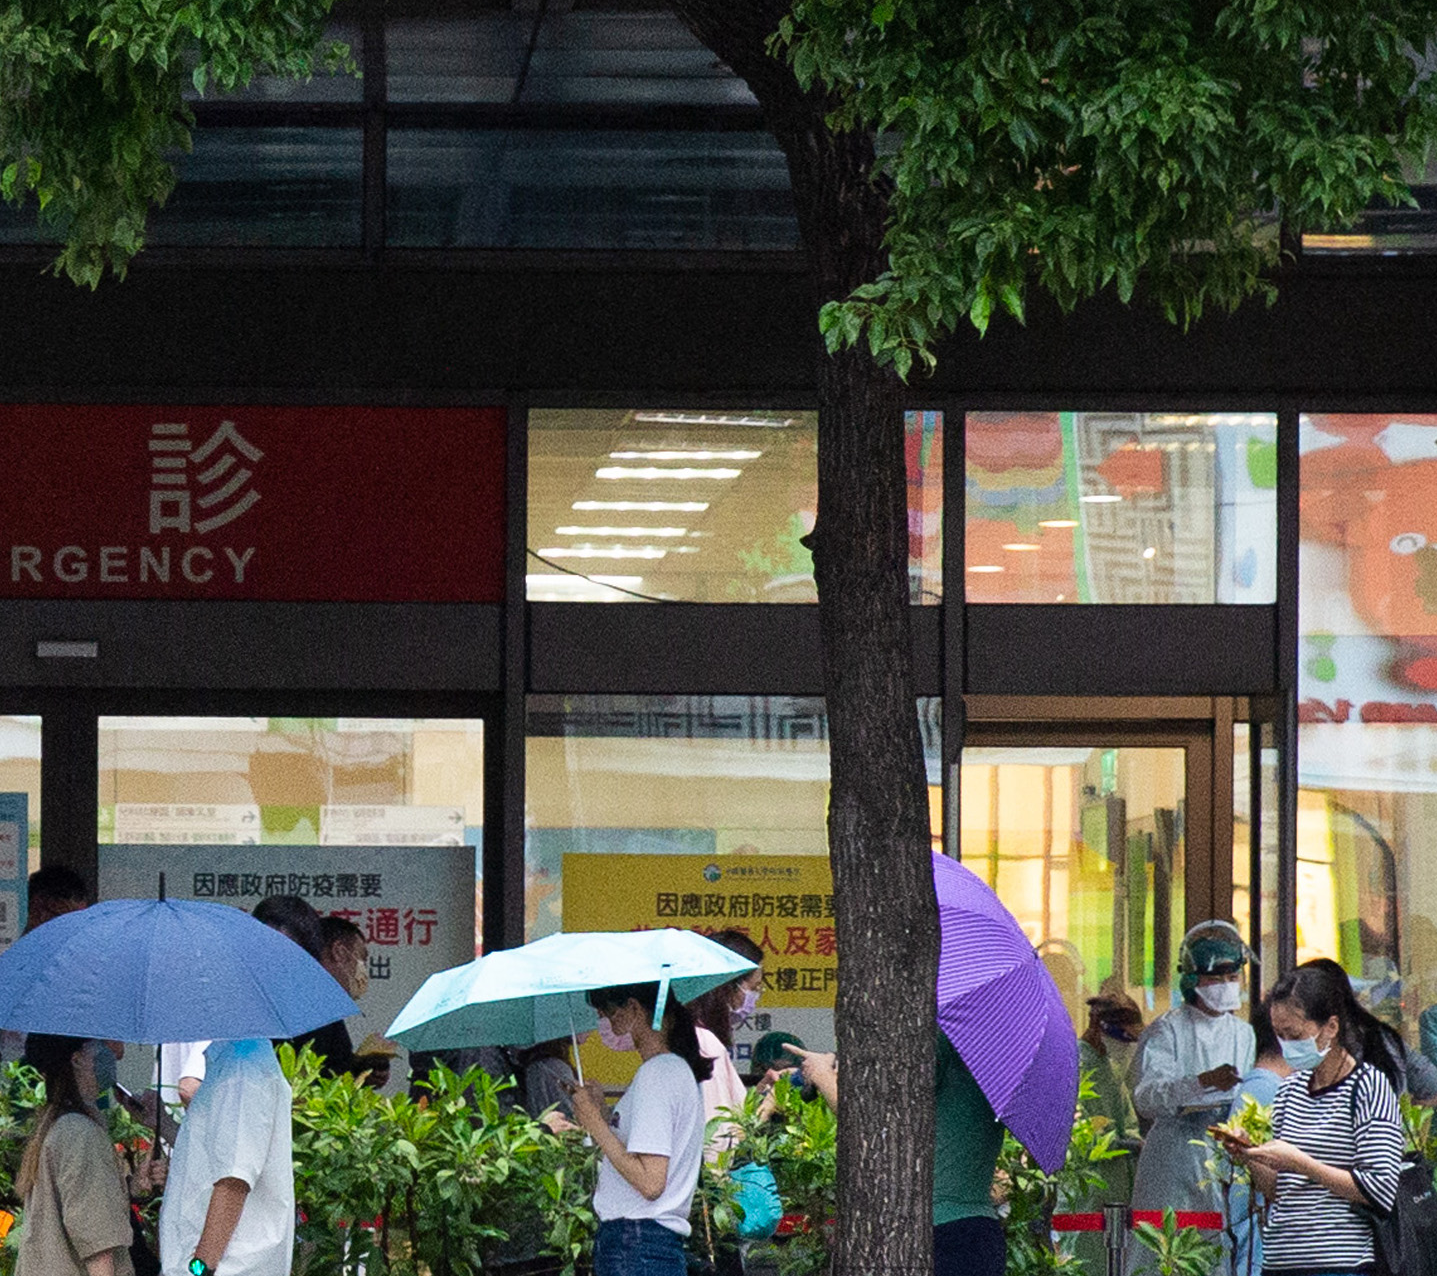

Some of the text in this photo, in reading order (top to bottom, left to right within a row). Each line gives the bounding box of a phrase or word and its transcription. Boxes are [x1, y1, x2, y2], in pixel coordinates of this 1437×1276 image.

[193, 873, 383, 897] 因應政府防疫需要
